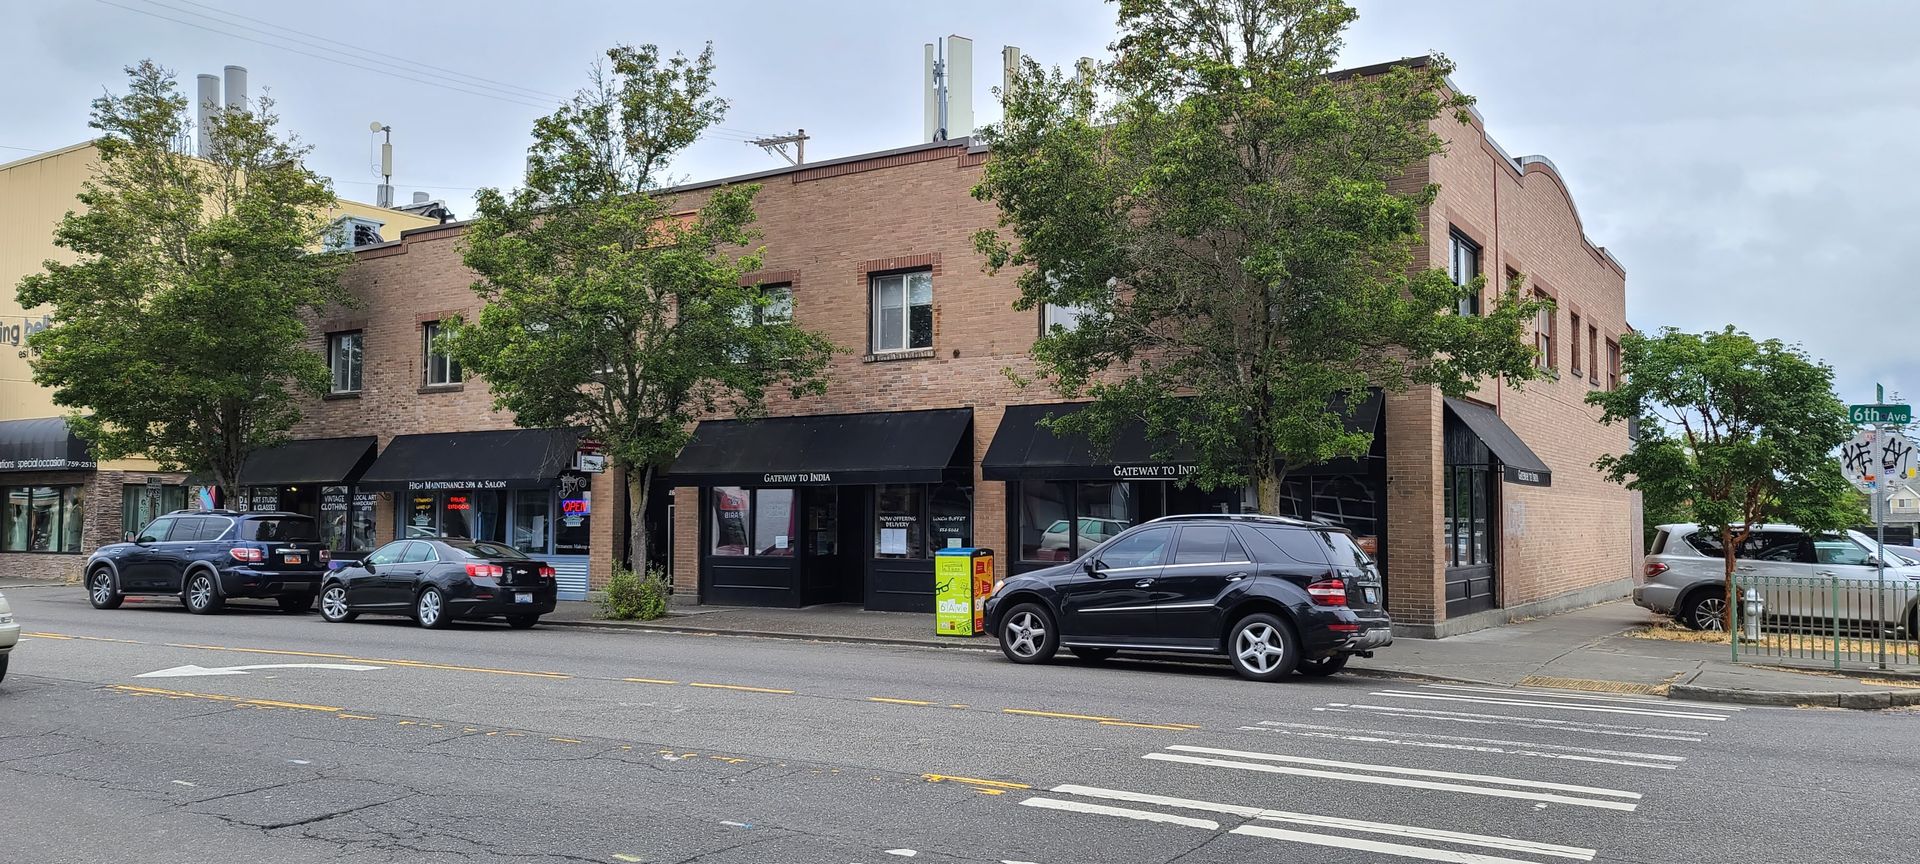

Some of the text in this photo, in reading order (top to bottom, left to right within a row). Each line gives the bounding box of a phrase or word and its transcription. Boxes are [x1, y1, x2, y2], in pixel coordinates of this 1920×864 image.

[1854, 408, 1907, 421] 6th Ave
[17, 457, 38, 470] special
[38, 456, 66, 468] occasion
[66, 460, 97, 468] 759-2513
[1113, 464, 1200, 477] GATEWAY TO INDI
[763, 472, 831, 483] GATEWAY TO INDIA
[424, 480, 465, 490] MAINTENANCE
[484, 480, 507, 489] SALON
[320, 503, 348, 511] CLOTHING
[563, 500, 587, 512] OPEN
